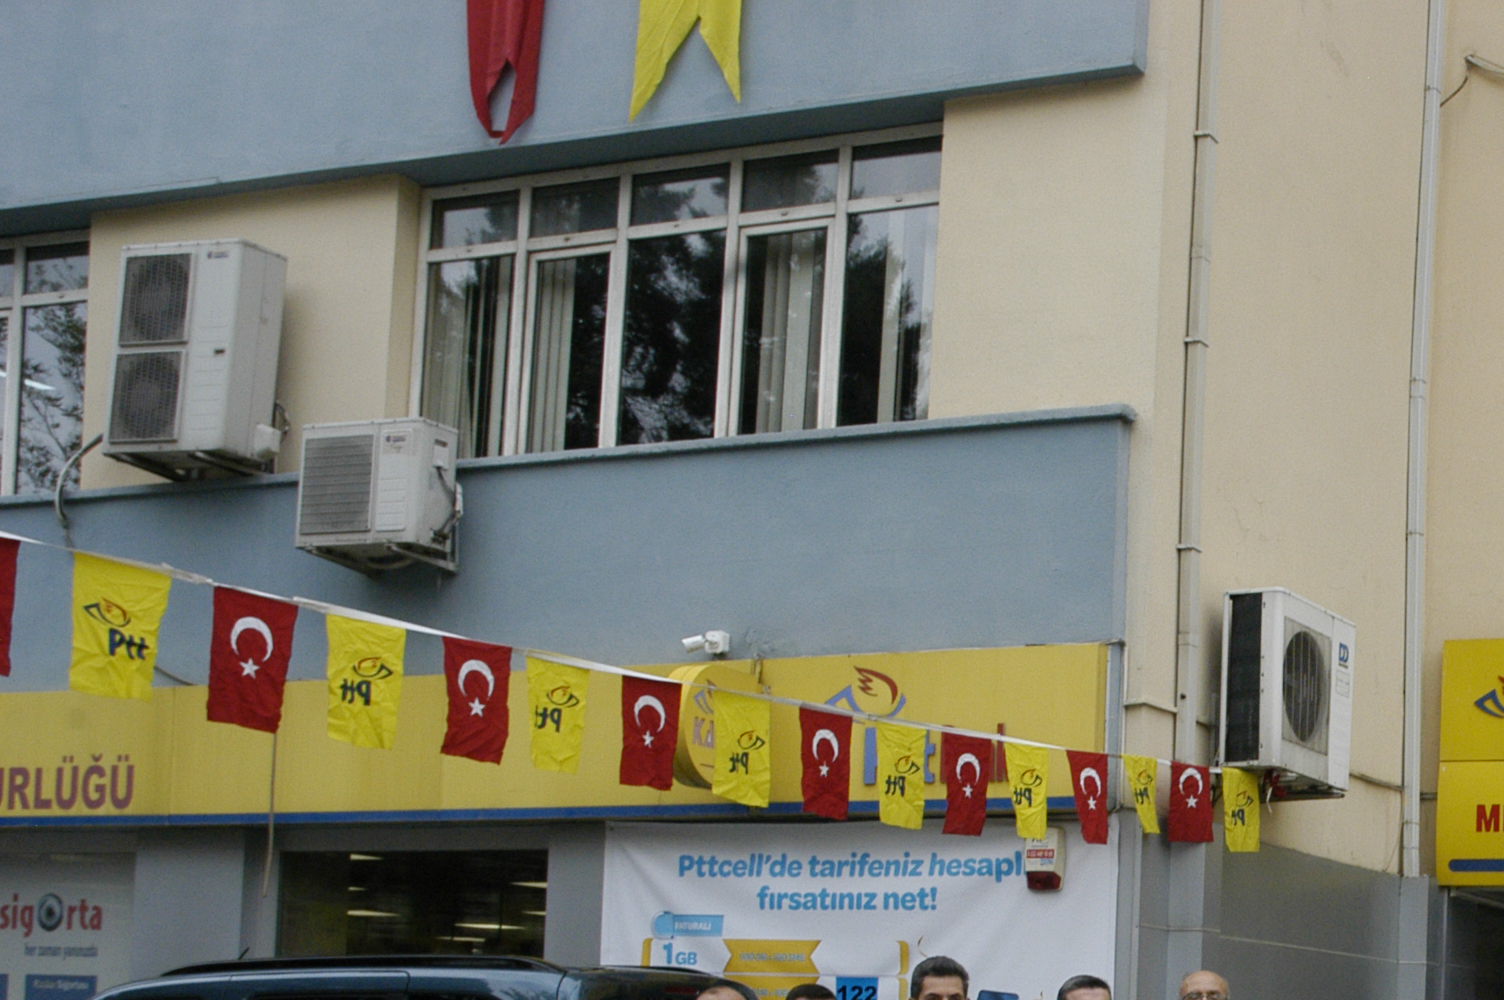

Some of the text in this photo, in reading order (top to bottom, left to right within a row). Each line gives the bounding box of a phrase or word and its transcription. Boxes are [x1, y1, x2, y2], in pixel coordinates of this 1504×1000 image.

[108, 628, 149, 660] Ptt
[808, 851, 923, 877] tarifeniz
[928, 851, 1025, 882] hesapl
[757, 886, 938, 911] fırsatınız net!
